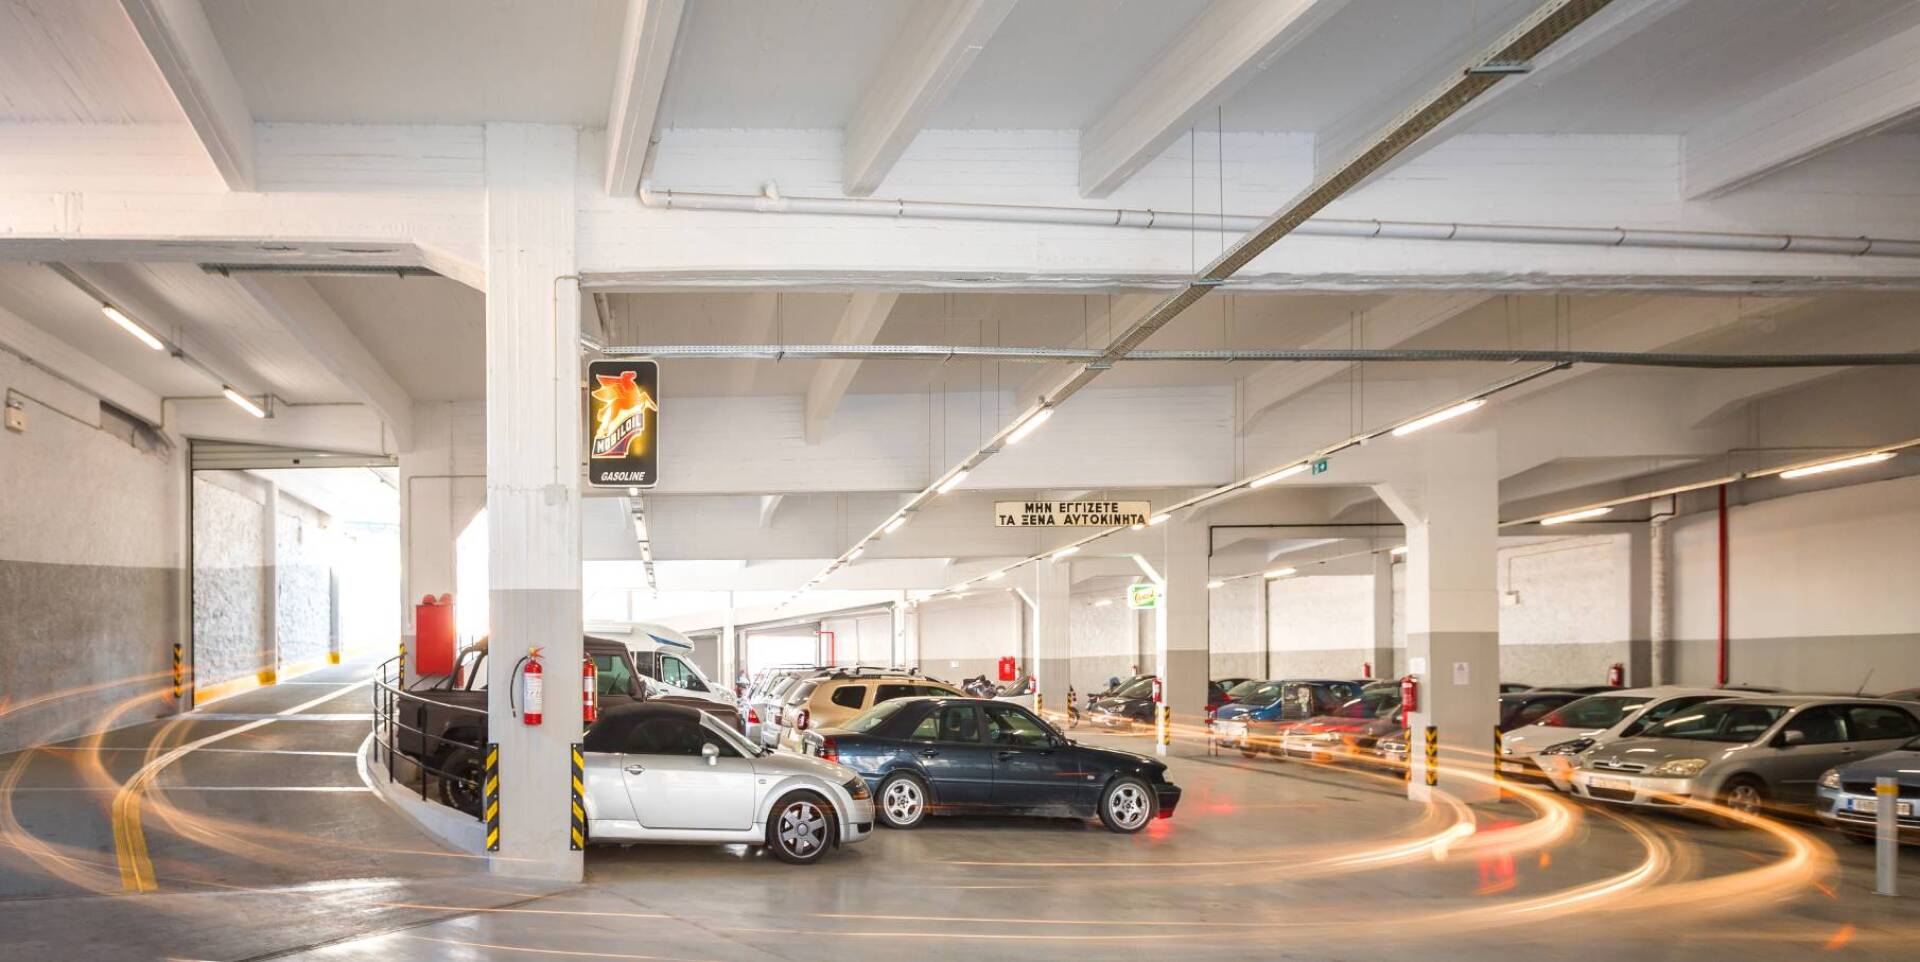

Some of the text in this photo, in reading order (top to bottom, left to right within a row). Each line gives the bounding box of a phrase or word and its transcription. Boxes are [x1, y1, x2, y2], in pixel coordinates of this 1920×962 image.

[596, 413, 642, 453] MOBILOIL
[601, 471, 645, 481] GASOLINE
[1025, 503, 1119, 513] ΜΗΝ ΕΓΓΙΖΕΤΕ
[1000, 514, 1146, 525] ΤΑ ΞΕΝΑ ΑΥΤΟΚΙΝΗΤΑ
